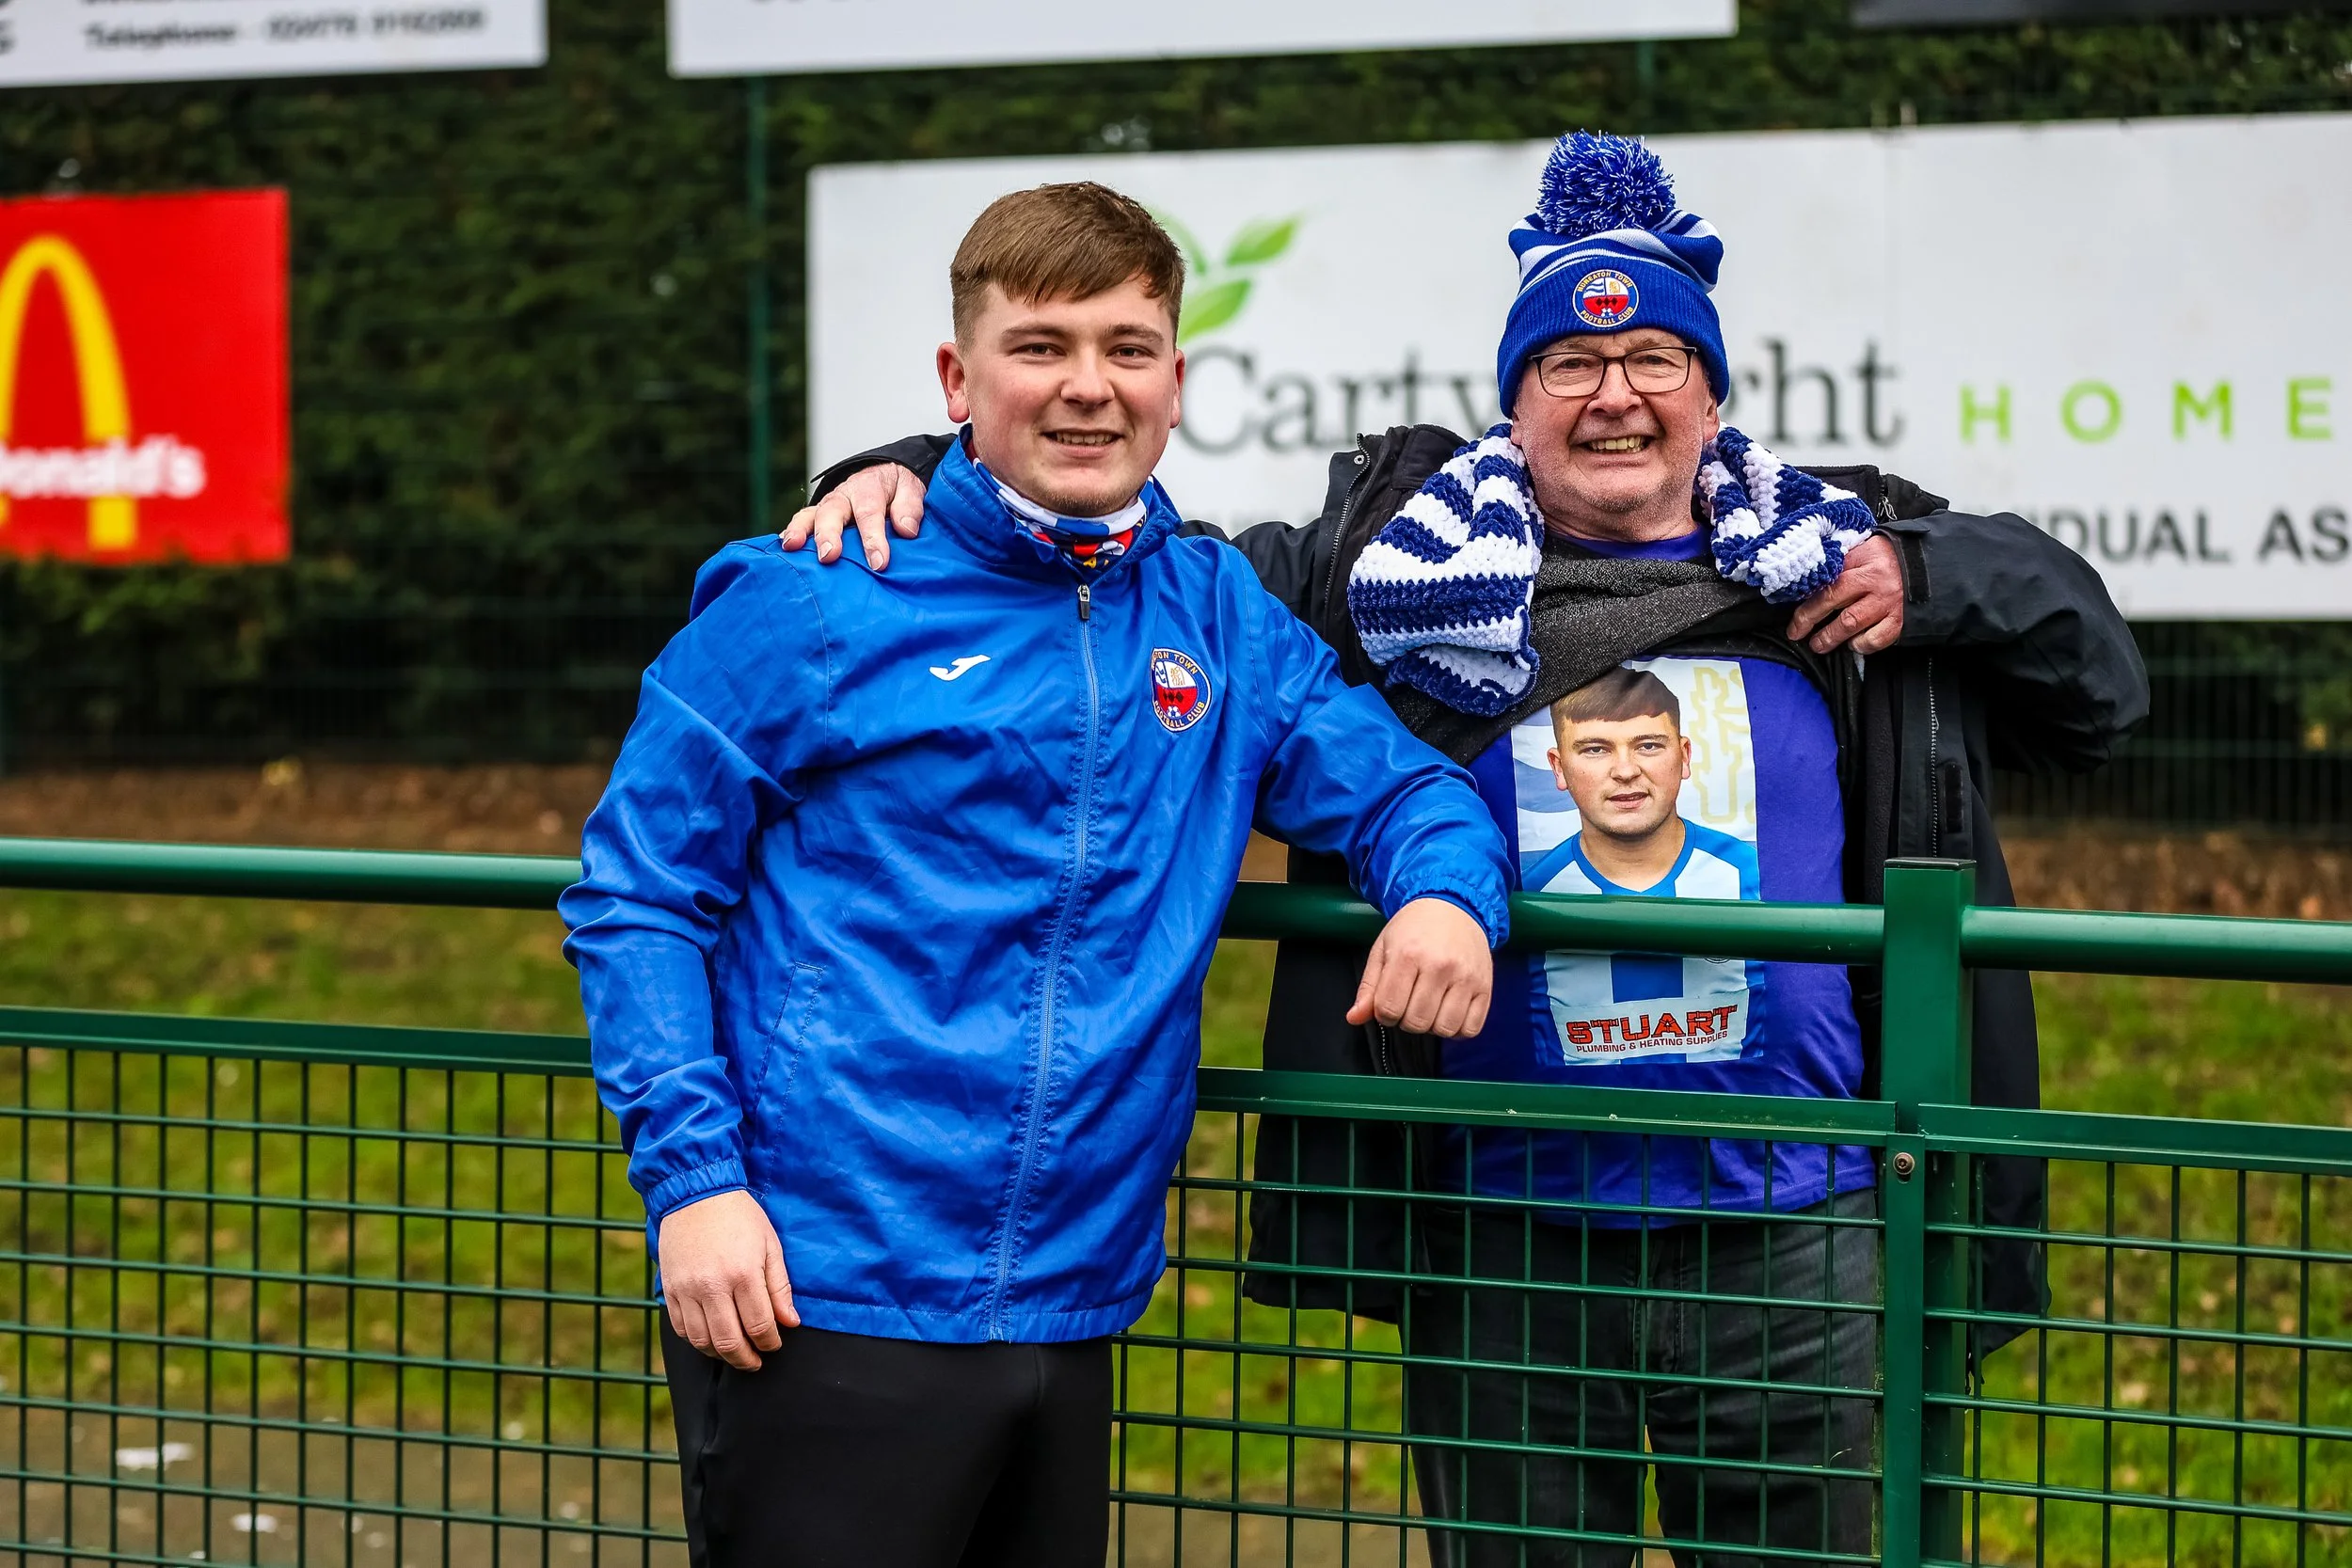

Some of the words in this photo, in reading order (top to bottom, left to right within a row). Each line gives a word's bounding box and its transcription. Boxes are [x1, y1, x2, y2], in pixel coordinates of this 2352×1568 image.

[1614, 273, 1633, 288] TOWN
[1581, 309, 1616, 325] FOOTBALL
[1618, 306, 1634, 321] CLUB
[0, 433, 205, 498] onald's
[2258, 506, 2349, 564] AS
[1174, 654, 1198, 674] TOWN
[1186, 701, 1205, 721] CLUB
[1565, 1005, 1738, 1044] STUART
[1576, 1043, 1626, 1053] PLUMBING
[1629, 1041, 1637, 1051] &
[1639, 1037, 1683, 1049] HEATING
[1686, 1030, 1728, 1046] SUPPLIES
